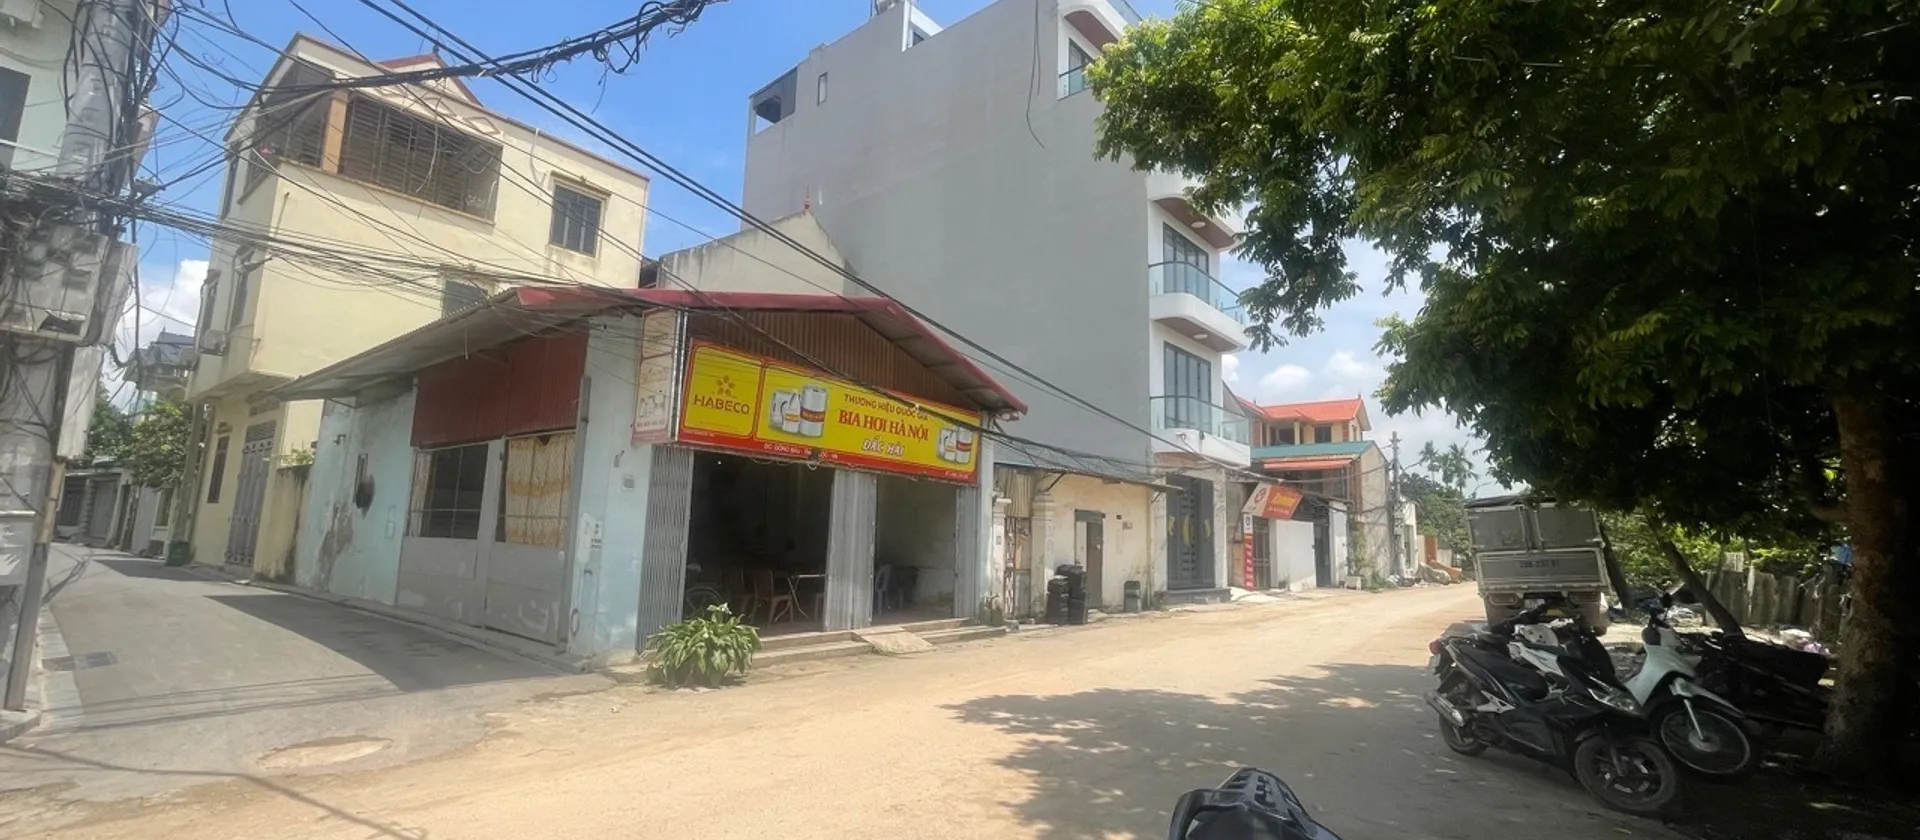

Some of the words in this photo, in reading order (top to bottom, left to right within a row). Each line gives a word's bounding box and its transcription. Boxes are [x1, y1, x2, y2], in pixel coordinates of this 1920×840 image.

[694, 394, 750, 414] HABECO
[839, 409, 861, 427] BIA
[863, 413, 887, 432] HƠI
[889, 419, 906, 437] HÀ
[907, 423, 929, 443] NỘI
